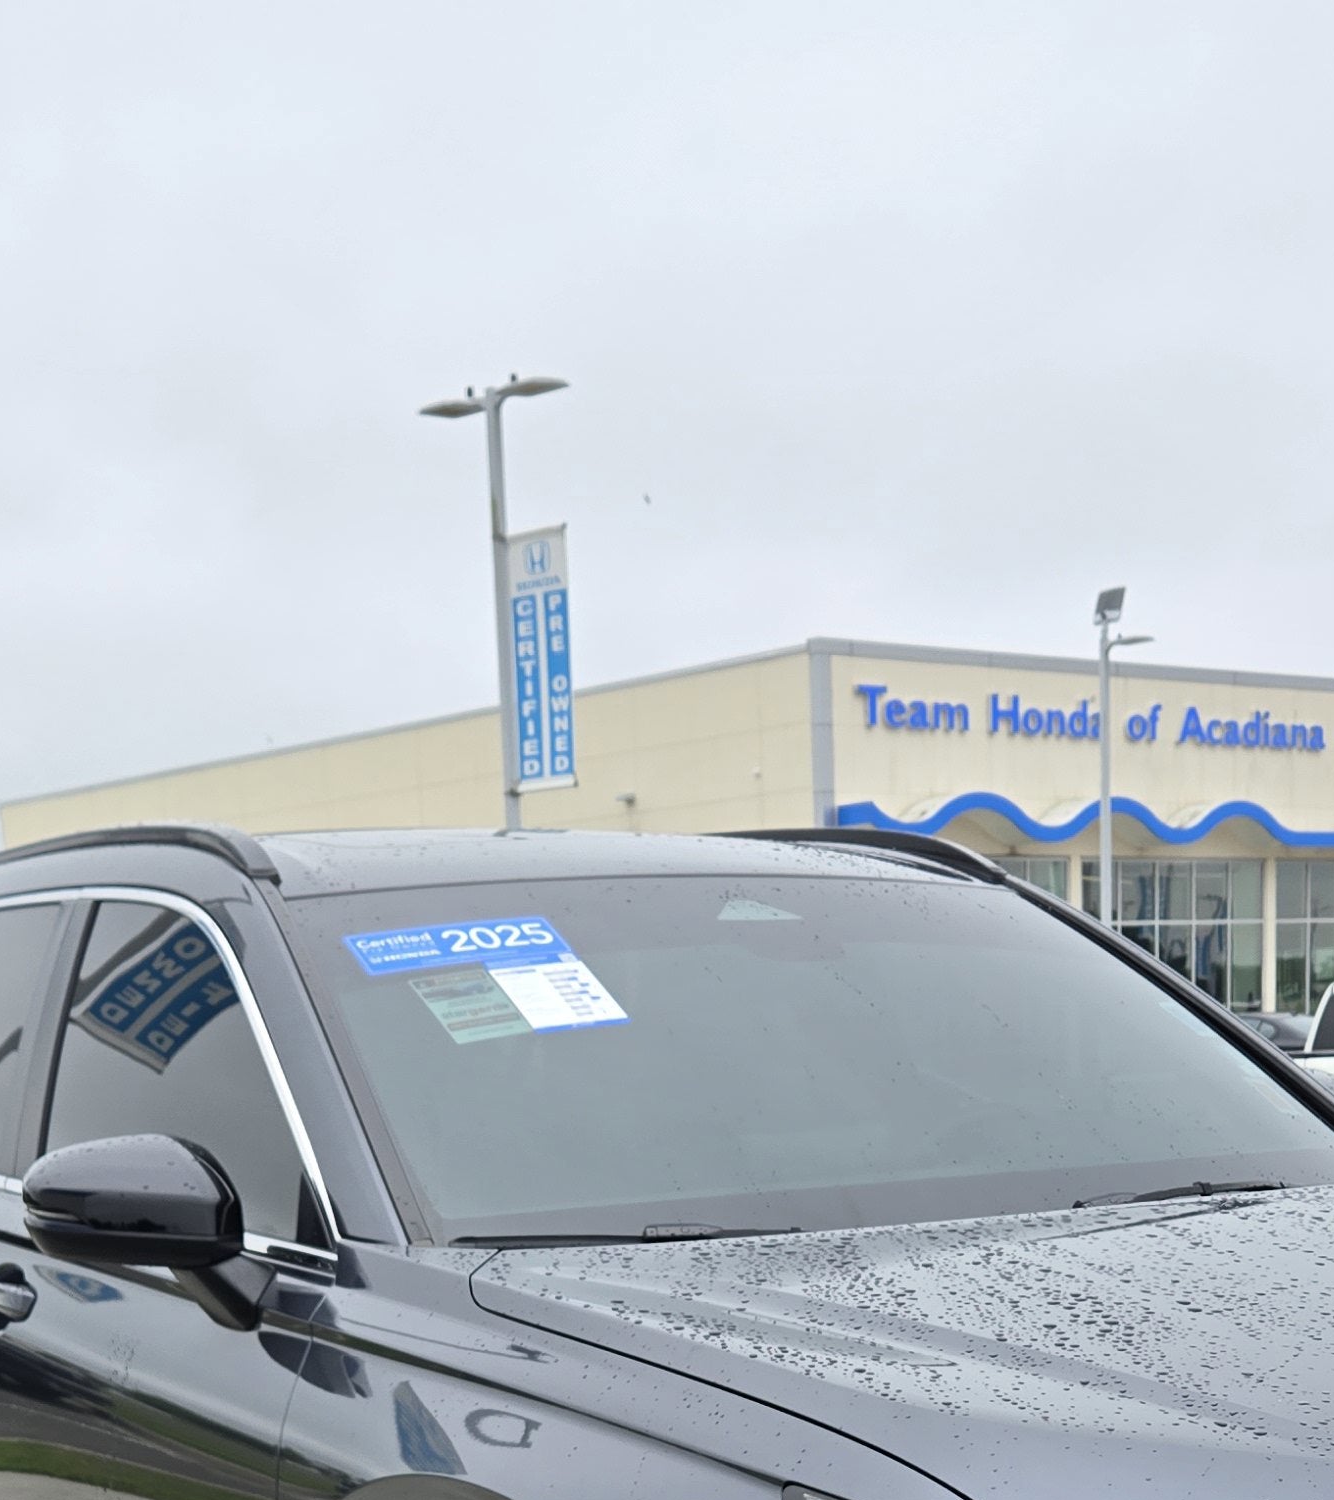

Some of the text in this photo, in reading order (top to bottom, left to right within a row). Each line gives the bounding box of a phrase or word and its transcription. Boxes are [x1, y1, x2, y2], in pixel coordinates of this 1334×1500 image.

[515, 600, 541, 776] CERTIFIED
[548, 594, 570, 772] PRE OWNED
[856, 684, 970, 731] Team
[1127, 704, 1162, 741] of
[1178, 706, 1326, 751] Acadiana
[441, 922, 555, 953] 2025
